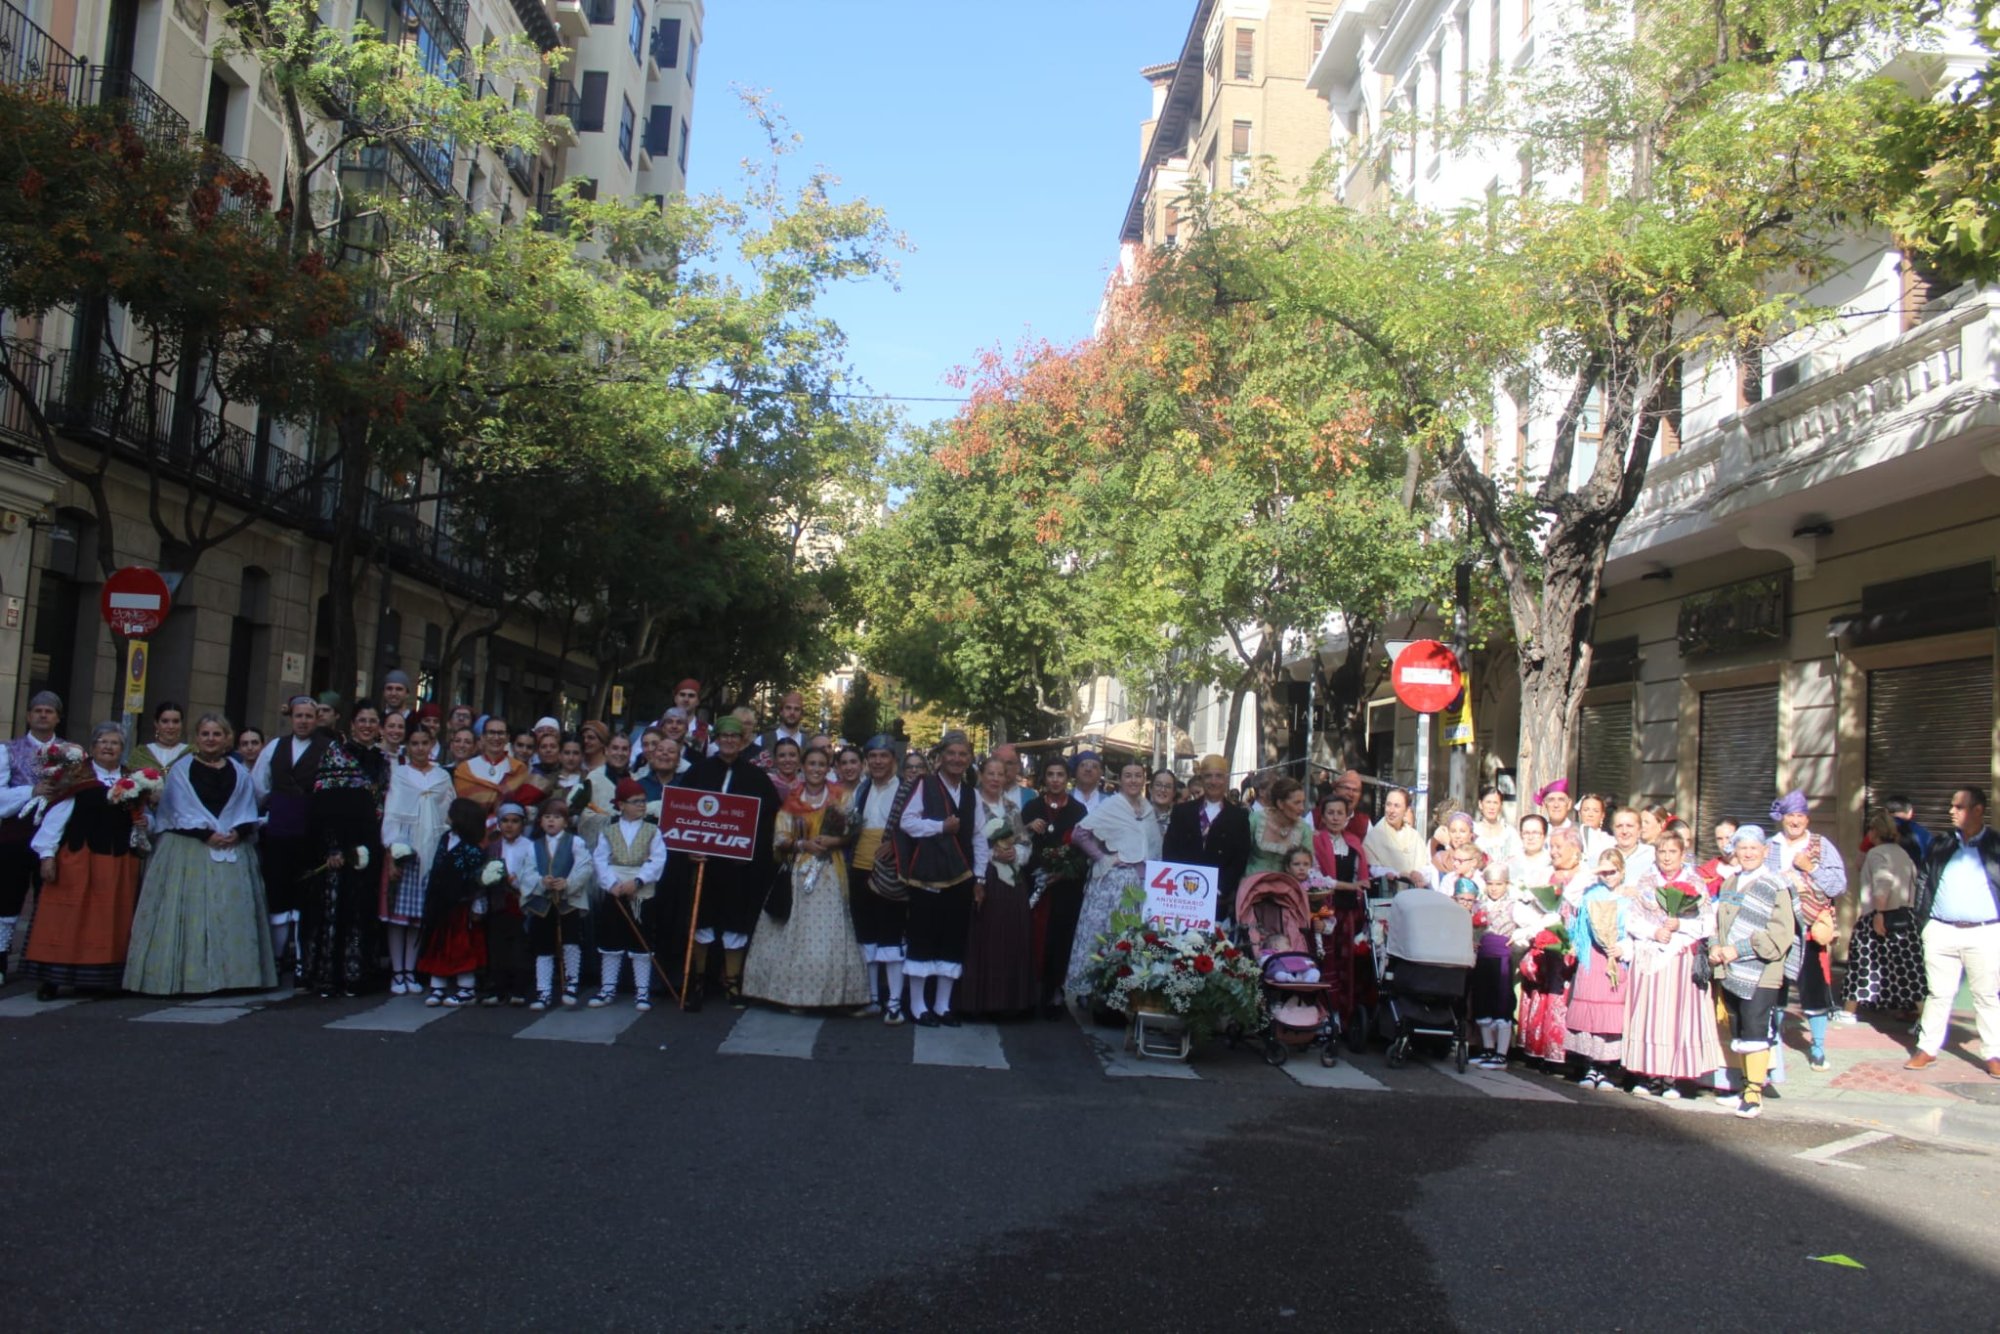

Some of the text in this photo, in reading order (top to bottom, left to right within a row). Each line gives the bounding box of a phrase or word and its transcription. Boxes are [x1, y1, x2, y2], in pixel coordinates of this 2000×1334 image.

[675, 817, 740, 832] CLUB CICLISTA
[663, 827, 752, 849] ACTUR
[1156, 896, 1205, 907] ANIVERSARIO
